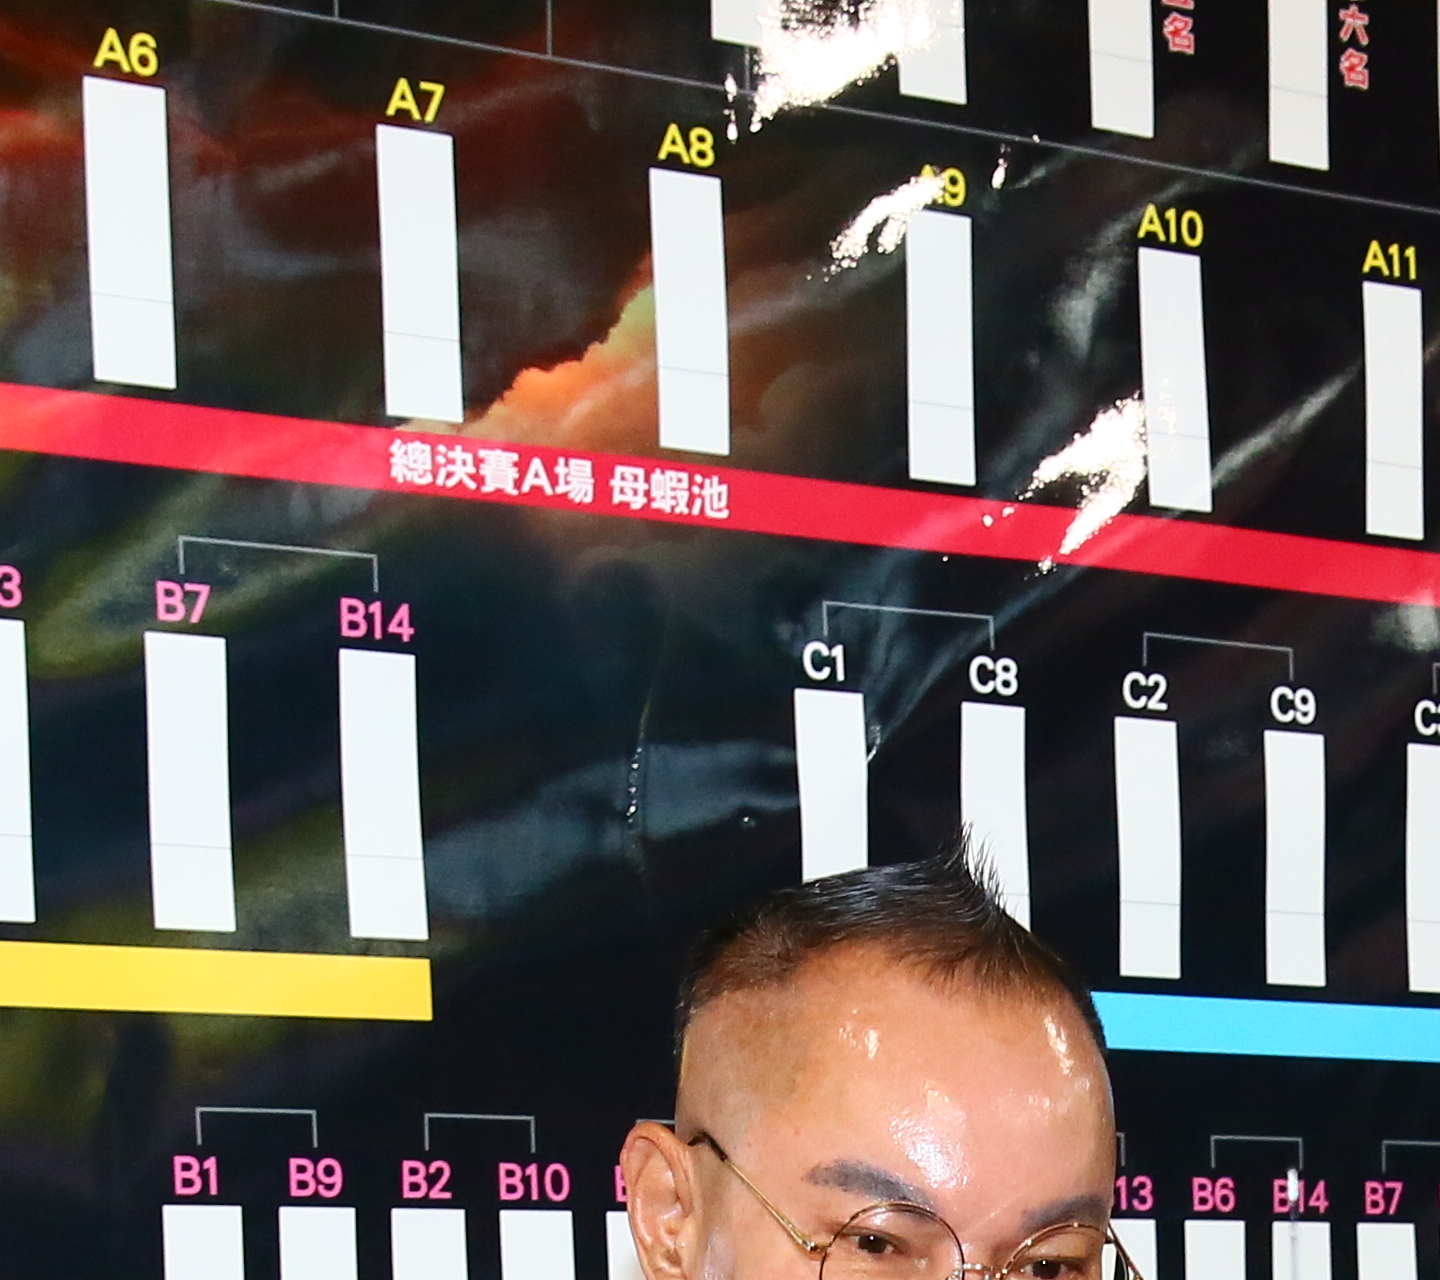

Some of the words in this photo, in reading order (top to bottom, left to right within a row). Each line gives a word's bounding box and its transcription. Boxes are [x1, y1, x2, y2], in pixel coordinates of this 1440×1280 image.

[1162, 0, 1195, 55] 名
[1338, 0, 1369, 90] 六名
[93, 27, 158, 77] A6
[385, 77, 445, 123] A7
[657, 123, 715, 167] A8
[1137, 205, 1204, 247] A10
[1362, 240, 1417, 280] A11
[388, 437, 595, 505] 總決賽A場
[608, 464, 731, 521] 母蝦池
[155, 580, 211, 622] B7
[339, 596, 415, 643] B14
[802, 640, 845, 682] C1
[969, 655, 1018, 696] C8
[1122, 671, 1168, 711] C2
[1270, 685, 1316, 725] C9
[173, 1155, 218, 1196] B1
[288, 1157, 343, 1199] B9
[401, 1159, 453, 1200] B2
[498, 1162, 571, 1202] B10
[1115, 1175, 1154, 1211] 13
[1192, 1176, 1236, 1213] B6
[1364, 1180, 1403, 1215] B7
